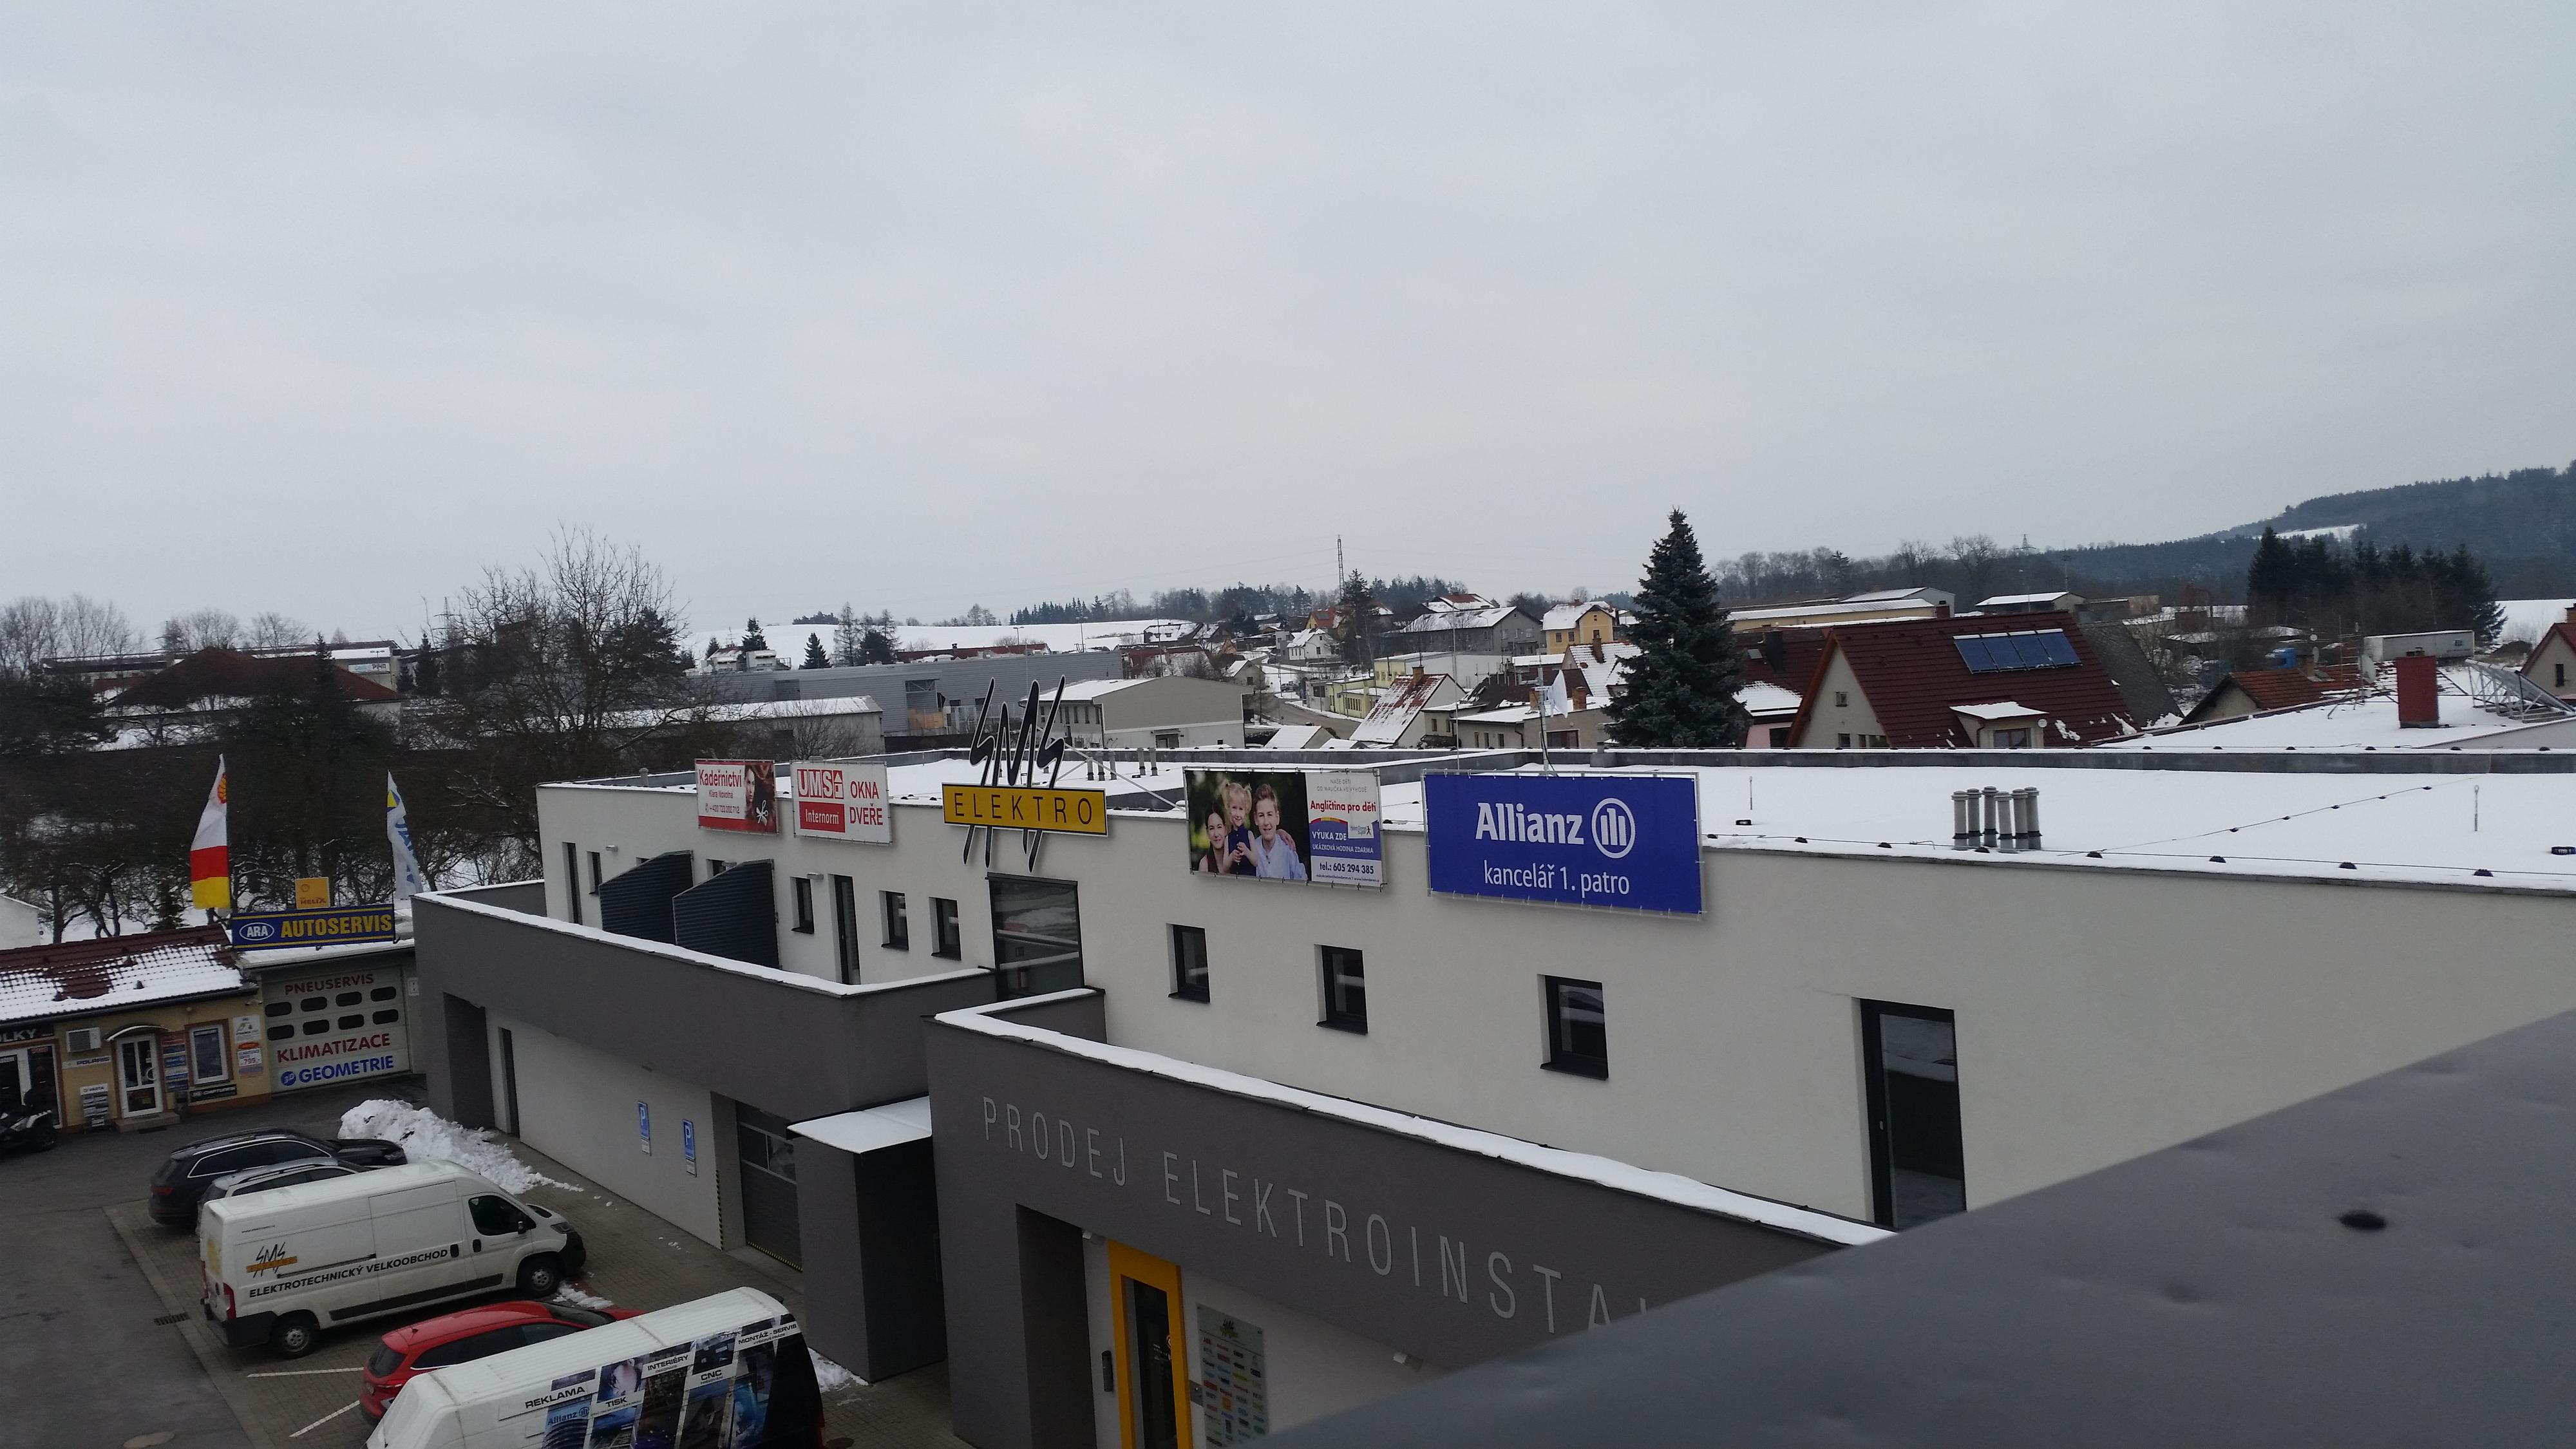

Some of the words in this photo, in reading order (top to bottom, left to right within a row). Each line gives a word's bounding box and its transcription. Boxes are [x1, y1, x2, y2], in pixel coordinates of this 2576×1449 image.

[699, 769, 742, 788] Kadeřnictví
[850, 781, 879, 799] OKNA
[849, 803, 883, 826] DVEŘE
[954, 793, 1092, 825] ELEKTRO
[1310, 800, 1346, 812] Angličtina
[1347, 804, 1360, 813] pro
[1362, 801, 1376, 811] děti
[806, 809, 839, 824] Internorm
[1475, 802, 1584, 845] Allianz
[1312, 829, 1334, 840] VÝUKA
[1335, 833, 1347, 841] ZDE
[1312, 842, 1336, 851] UKÁZKOVÁ
[1320, 862, 1332, 871] tel.:
[1332, 863, 1345, 871] 605
[1347, 864, 1359, 873] 294
[1361, 865, 1374, 874] 385
[1484, 859, 1555, 889] kancelář
[1560, 867, 1575, 891] 1.
[1580, 871, 1630, 898] patro
[246, 925, 269, 938] ARA
[281, 914, 392, 938] AUTOSERVIS
[285, 974, 374, 995] PNEUSERVIS
[0, 1028, 37, 1044] LKY
[278, 1033, 390, 1063] KLIMATIZACE
[77, 1057, 110, 1066] POLARIS
[299, 1056, 394, 1083] GEOMETRIE
[639, 1107, 646, 1126] P
[685, 1125, 691, 1146] P
[983, 1096, 1126, 1186] PRODEJ
[1163, 1150, 1647, 1334] ELEKTROINSTA
[249, 1265, 364, 1298] ELEKTROTECHNICKÝ
[366, 1249, 448, 1273] VELKOOBCHOD
[738, 1331, 769, 1345] MONTÁŽ
[773, 1323, 797, 1335] SERVIS
[648, 1354, 688, 1370] INTERIÉRY
[701, 1369, 723, 1381] CNC
[525, 1386, 585, 1409] REKLAMA
[605, 1396, 627, 1408] TISK
[547, 1411, 578, 1426] Allianz
